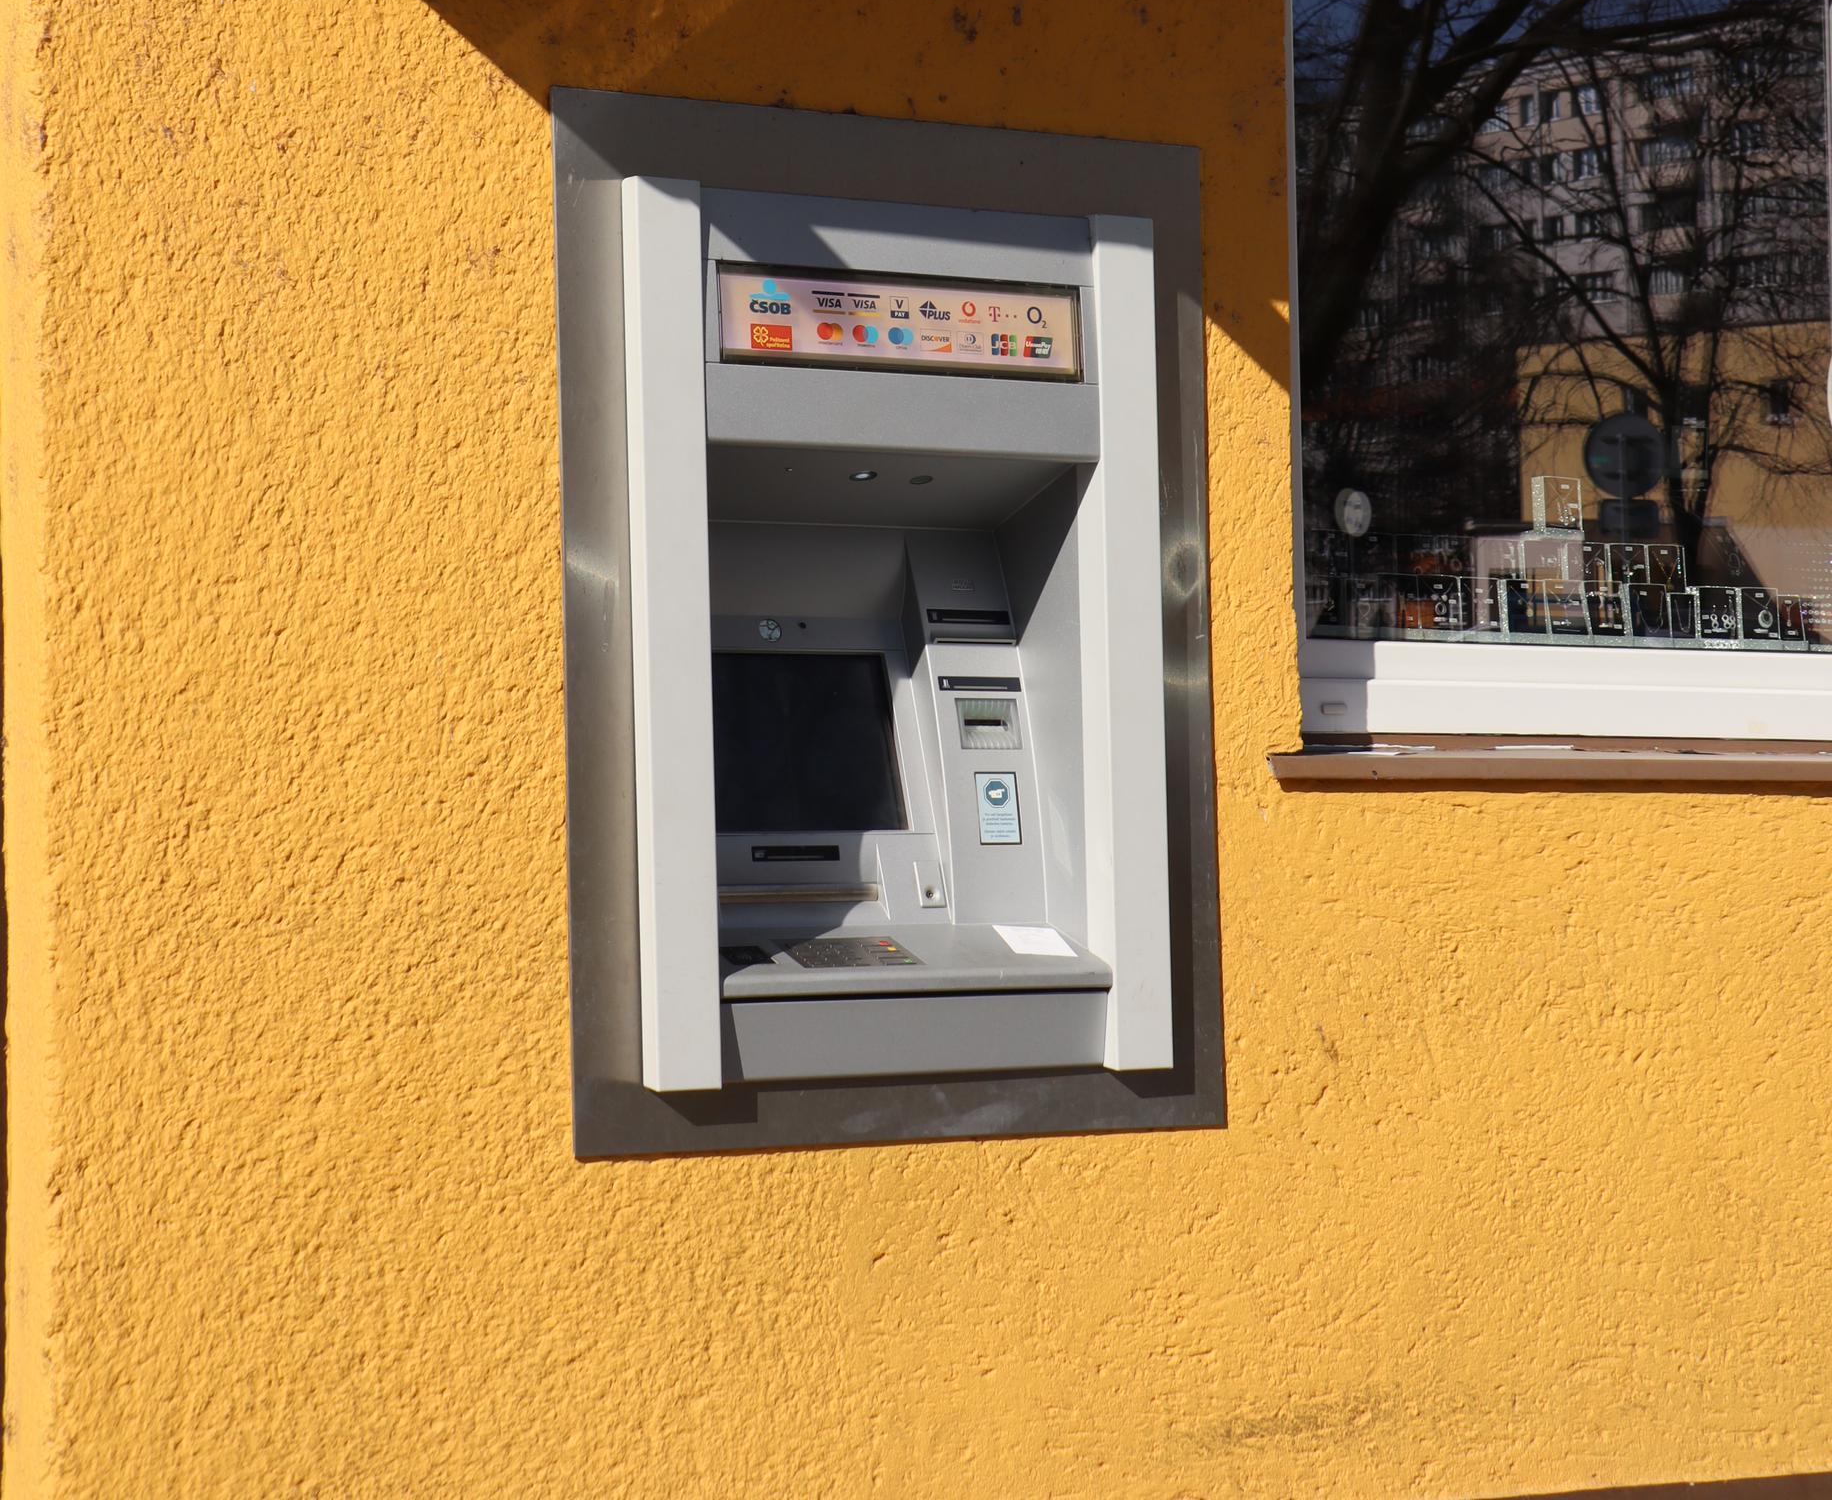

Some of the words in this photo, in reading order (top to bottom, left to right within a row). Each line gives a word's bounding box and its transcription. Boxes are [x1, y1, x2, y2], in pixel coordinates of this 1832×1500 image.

[750, 299, 791, 315] ČSOB
[817, 297, 842, 309] VISA
[852, 298, 877, 310] VISA
[894, 299, 904, 309] V
[928, 310, 950, 321] PLUS
[921, 334, 950, 343] DISCOVER
[991, 341, 1017, 350] JCB
